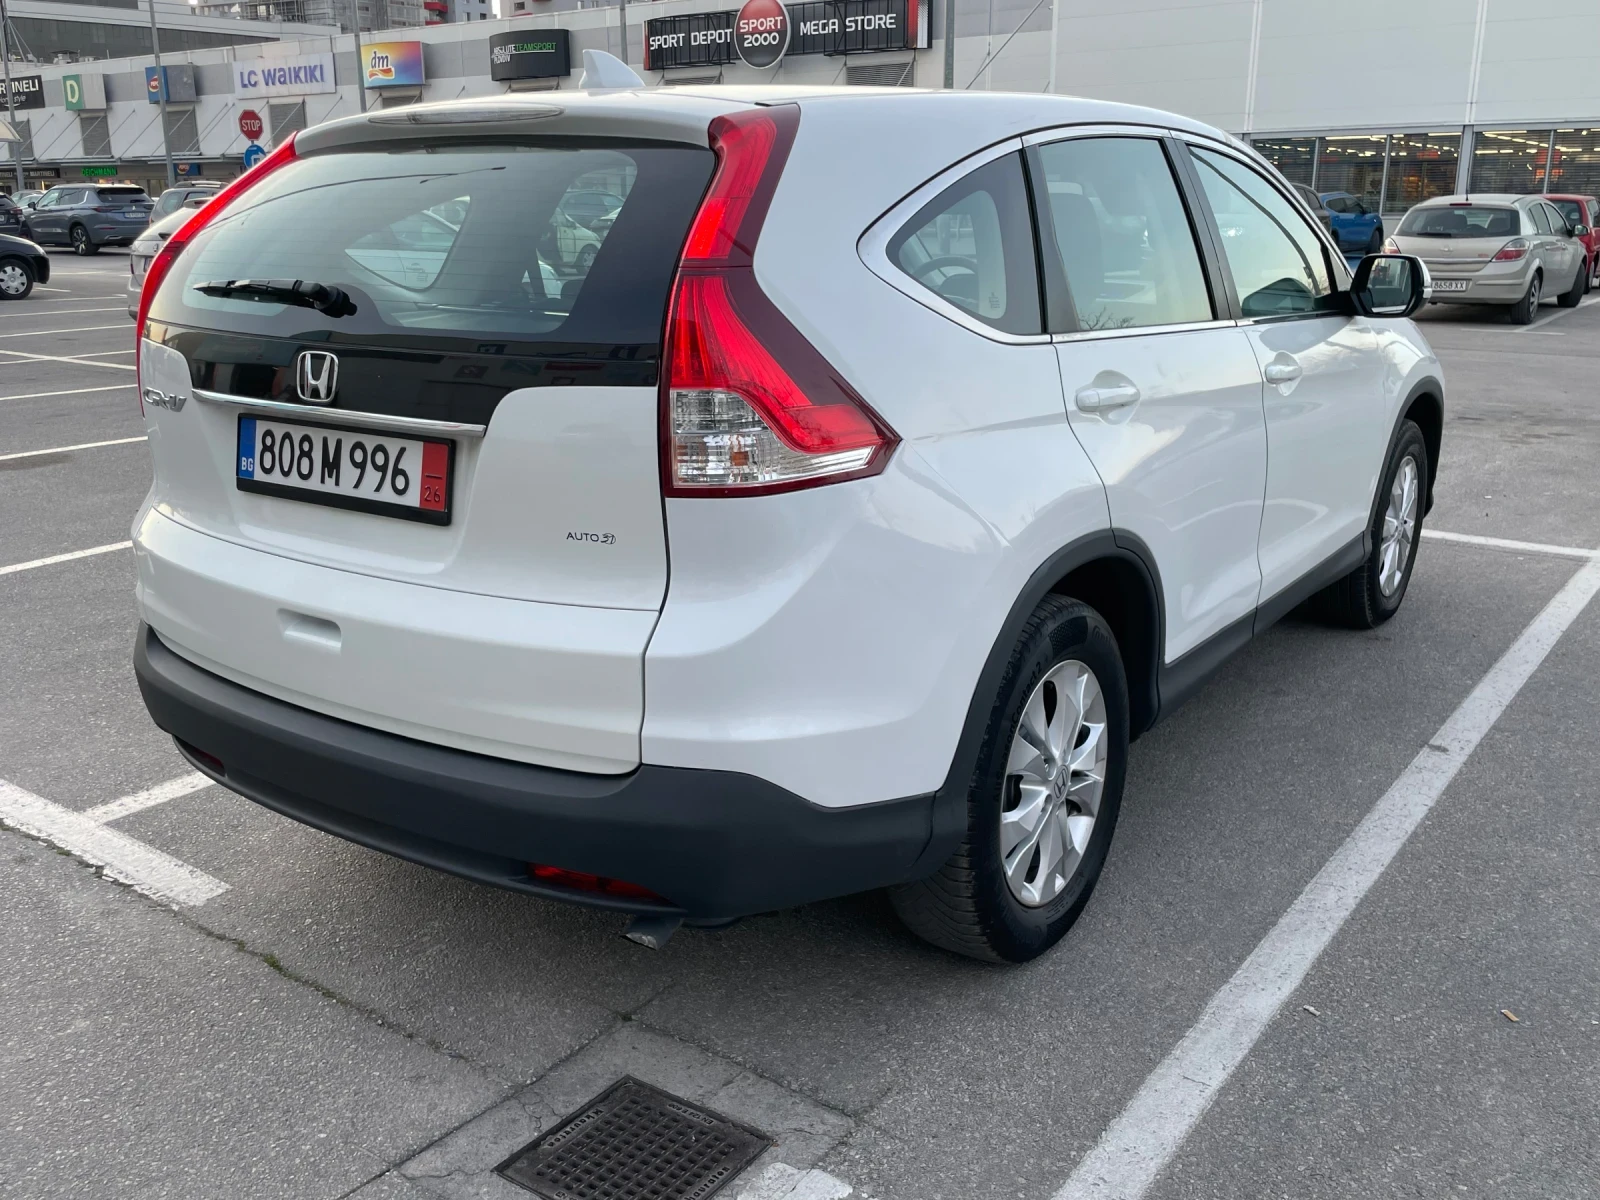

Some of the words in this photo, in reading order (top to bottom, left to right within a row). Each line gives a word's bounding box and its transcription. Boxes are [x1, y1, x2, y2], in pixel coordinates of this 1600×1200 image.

[740, 16, 783, 33] SPORT
[800, 18, 839, 36] MEGA
[845, 13, 897, 32] STORE
[649, 33, 685, 50] SPORT
[690, 28, 733, 46] DEPOT
[743, 32, 780, 48] 2000
[370, 51, 390, 69] dm
[0, 78, 39, 95] RINELI
[240, 69, 258, 89] LC
[66, 83, 80, 104] D
[241, 119, 261, 131] STOP
[81, 167, 117, 177] DEICHMANN
[241, 456, 254, 472] BG
[259, 428, 314, 481] 808
[320, 435, 343, 488] M
[349, 440, 410, 496] 996
[424, 485, 441, 504] 26
[566, 531, 600, 543] AUTO
[1036, 661, 1043, 675] 2
